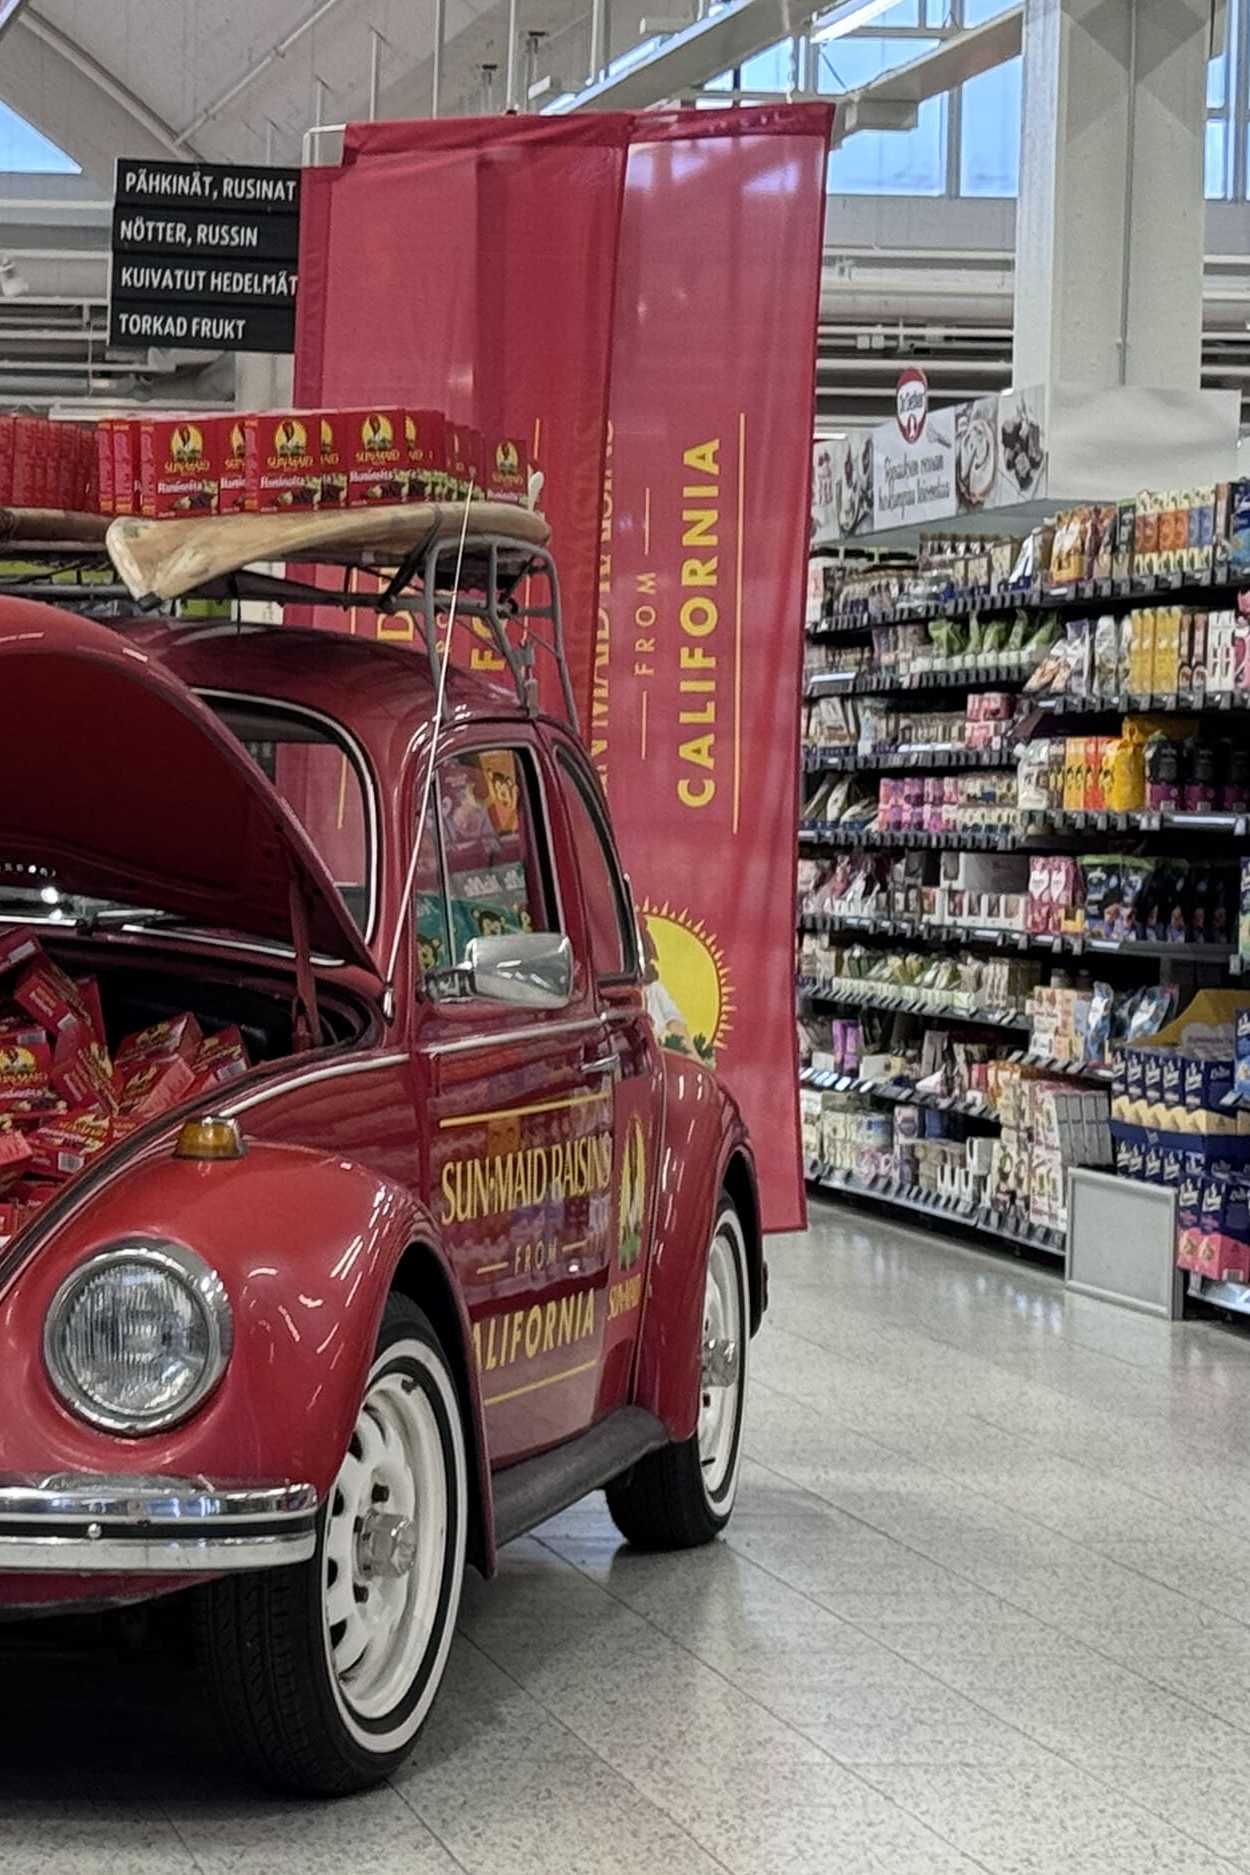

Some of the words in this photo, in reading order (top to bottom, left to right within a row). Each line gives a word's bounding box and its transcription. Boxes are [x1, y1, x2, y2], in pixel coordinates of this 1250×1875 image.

[125, 168, 218, 200] PÄHKINÄT,
[222, 177, 297, 202] RUSINAT
[120, 215, 192, 247] NÖTTER,
[197, 224, 258, 247] RUSSIN
[121, 266, 206, 291] KUIVATUT
[210, 270, 298, 297] HEDELMÄT
[118, 313, 187, 337] TORKAD
[191, 317, 247, 341] FRUKT
[634, 572, 656, 677] FROM
[677, 438, 720, 808] CALIFORNIA
[551, 1133, 613, 1200] RAISINS
[515, 1239, 558, 1275] FROM
